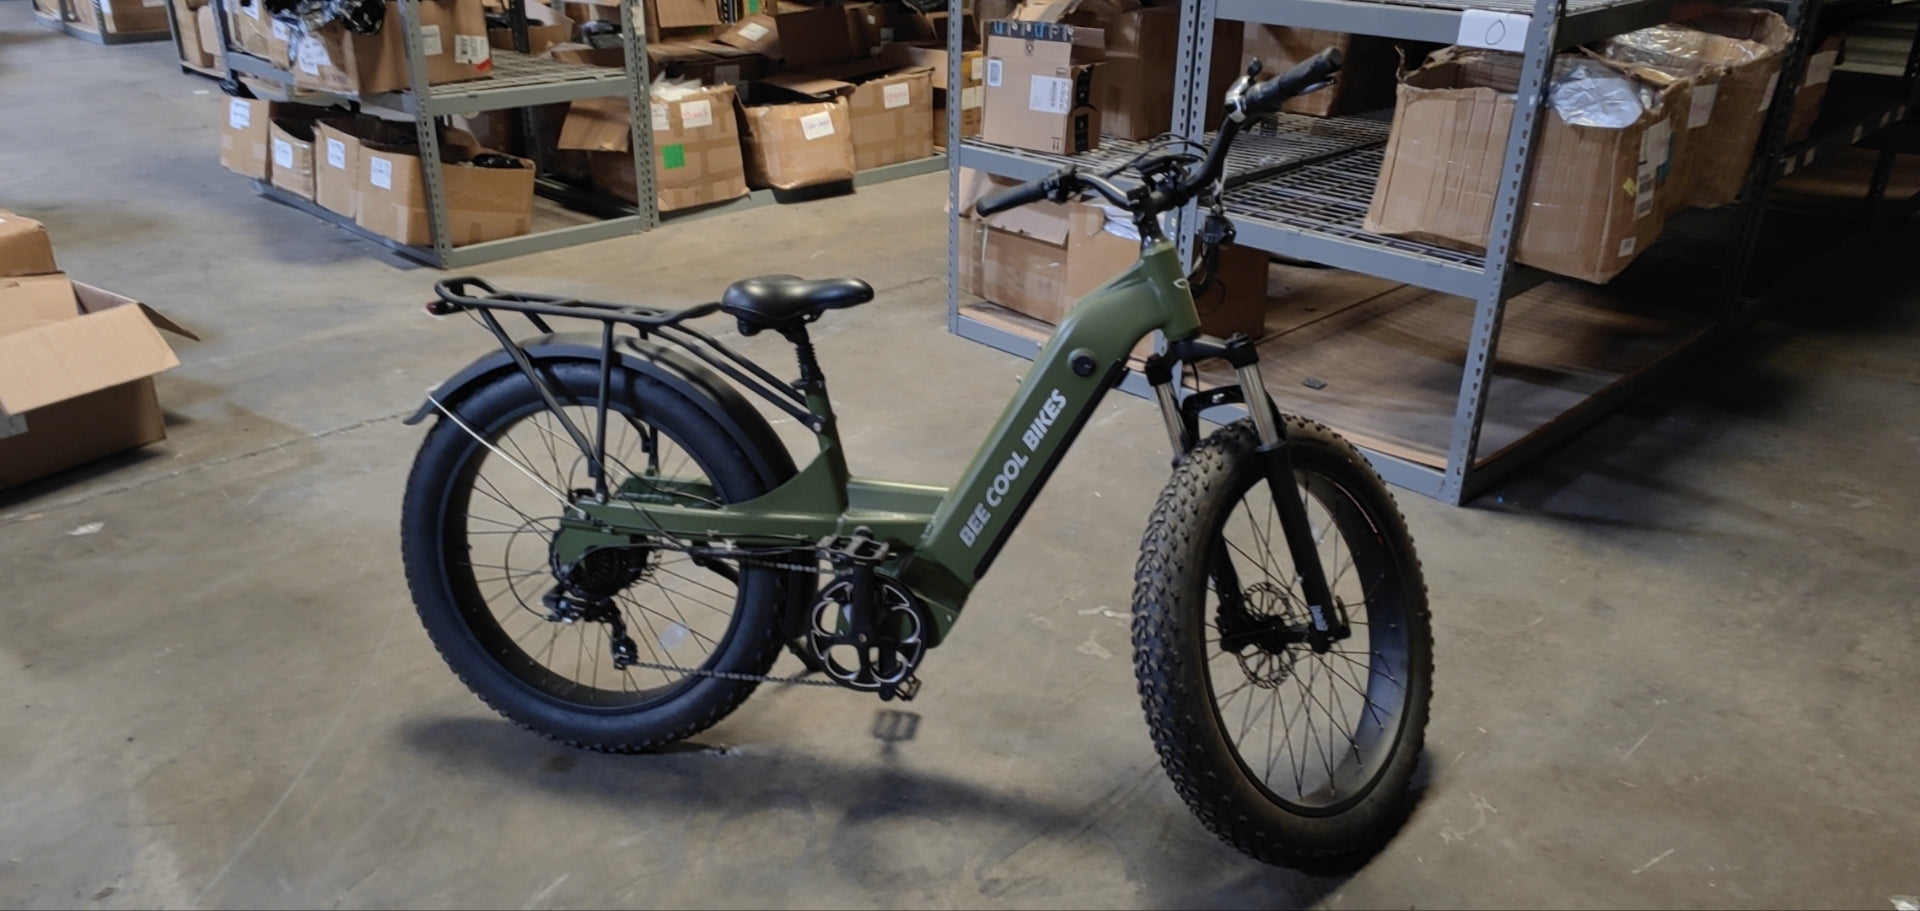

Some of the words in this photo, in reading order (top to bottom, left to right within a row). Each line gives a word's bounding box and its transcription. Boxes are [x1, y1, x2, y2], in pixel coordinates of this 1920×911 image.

[959, 503, 991, 548] BEE
[986, 451, 1029, 507] COOL
[1022, 388, 1067, 452] BIKES
